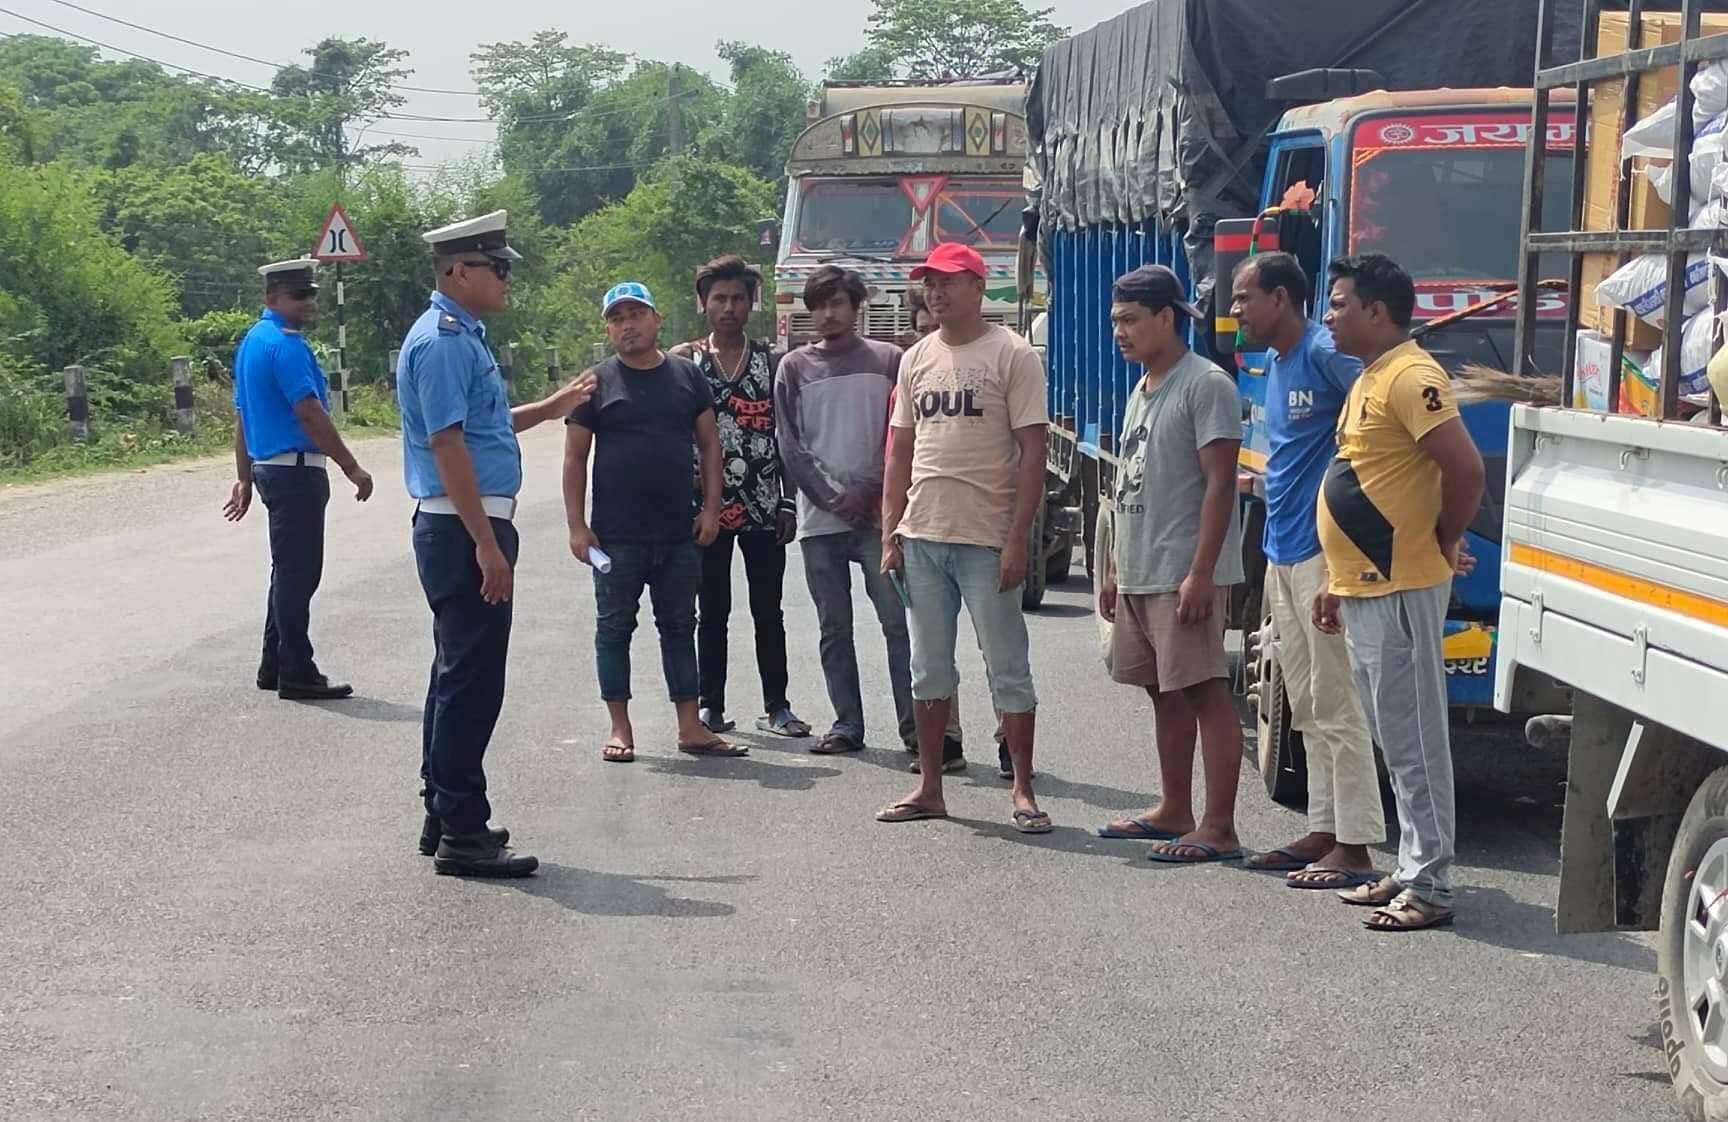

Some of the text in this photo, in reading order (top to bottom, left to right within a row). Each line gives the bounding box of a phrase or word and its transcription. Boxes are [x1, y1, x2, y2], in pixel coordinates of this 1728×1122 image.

[1289, 390, 1313, 406] BN
[1422, 387, 1442, 411] 3
[1658, 976, 1686, 1079] apollo
